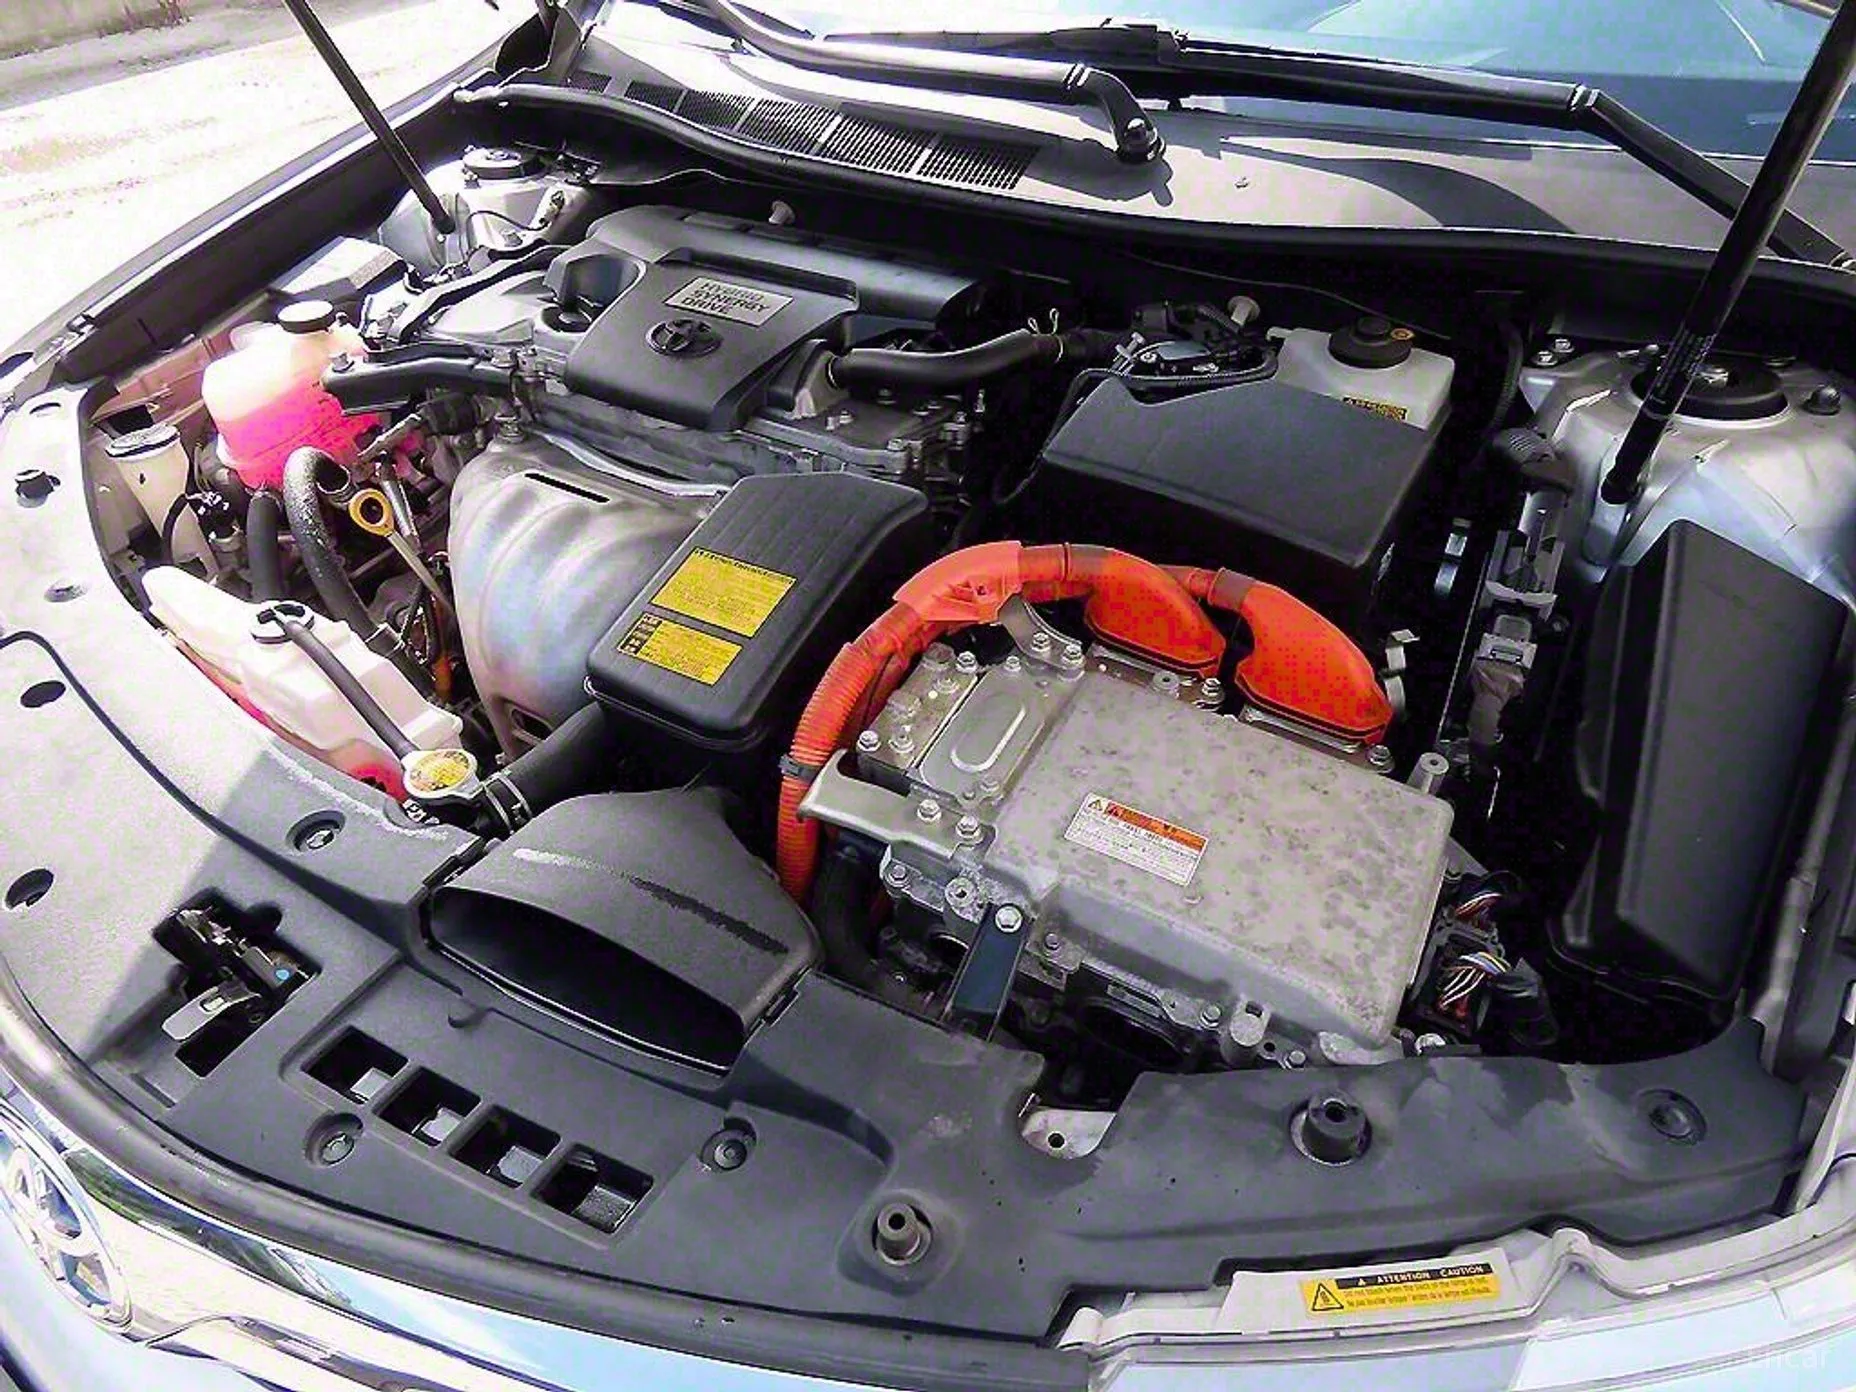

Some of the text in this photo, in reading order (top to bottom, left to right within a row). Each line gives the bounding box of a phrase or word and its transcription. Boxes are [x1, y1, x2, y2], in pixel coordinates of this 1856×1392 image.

[700, 282, 765, 301] HYBRID
[681, 297, 732, 314] DRIVE
[691, 290, 770, 313] SYNERGY
[1377, 1265, 1484, 1283] ATTENTION CAUTION
